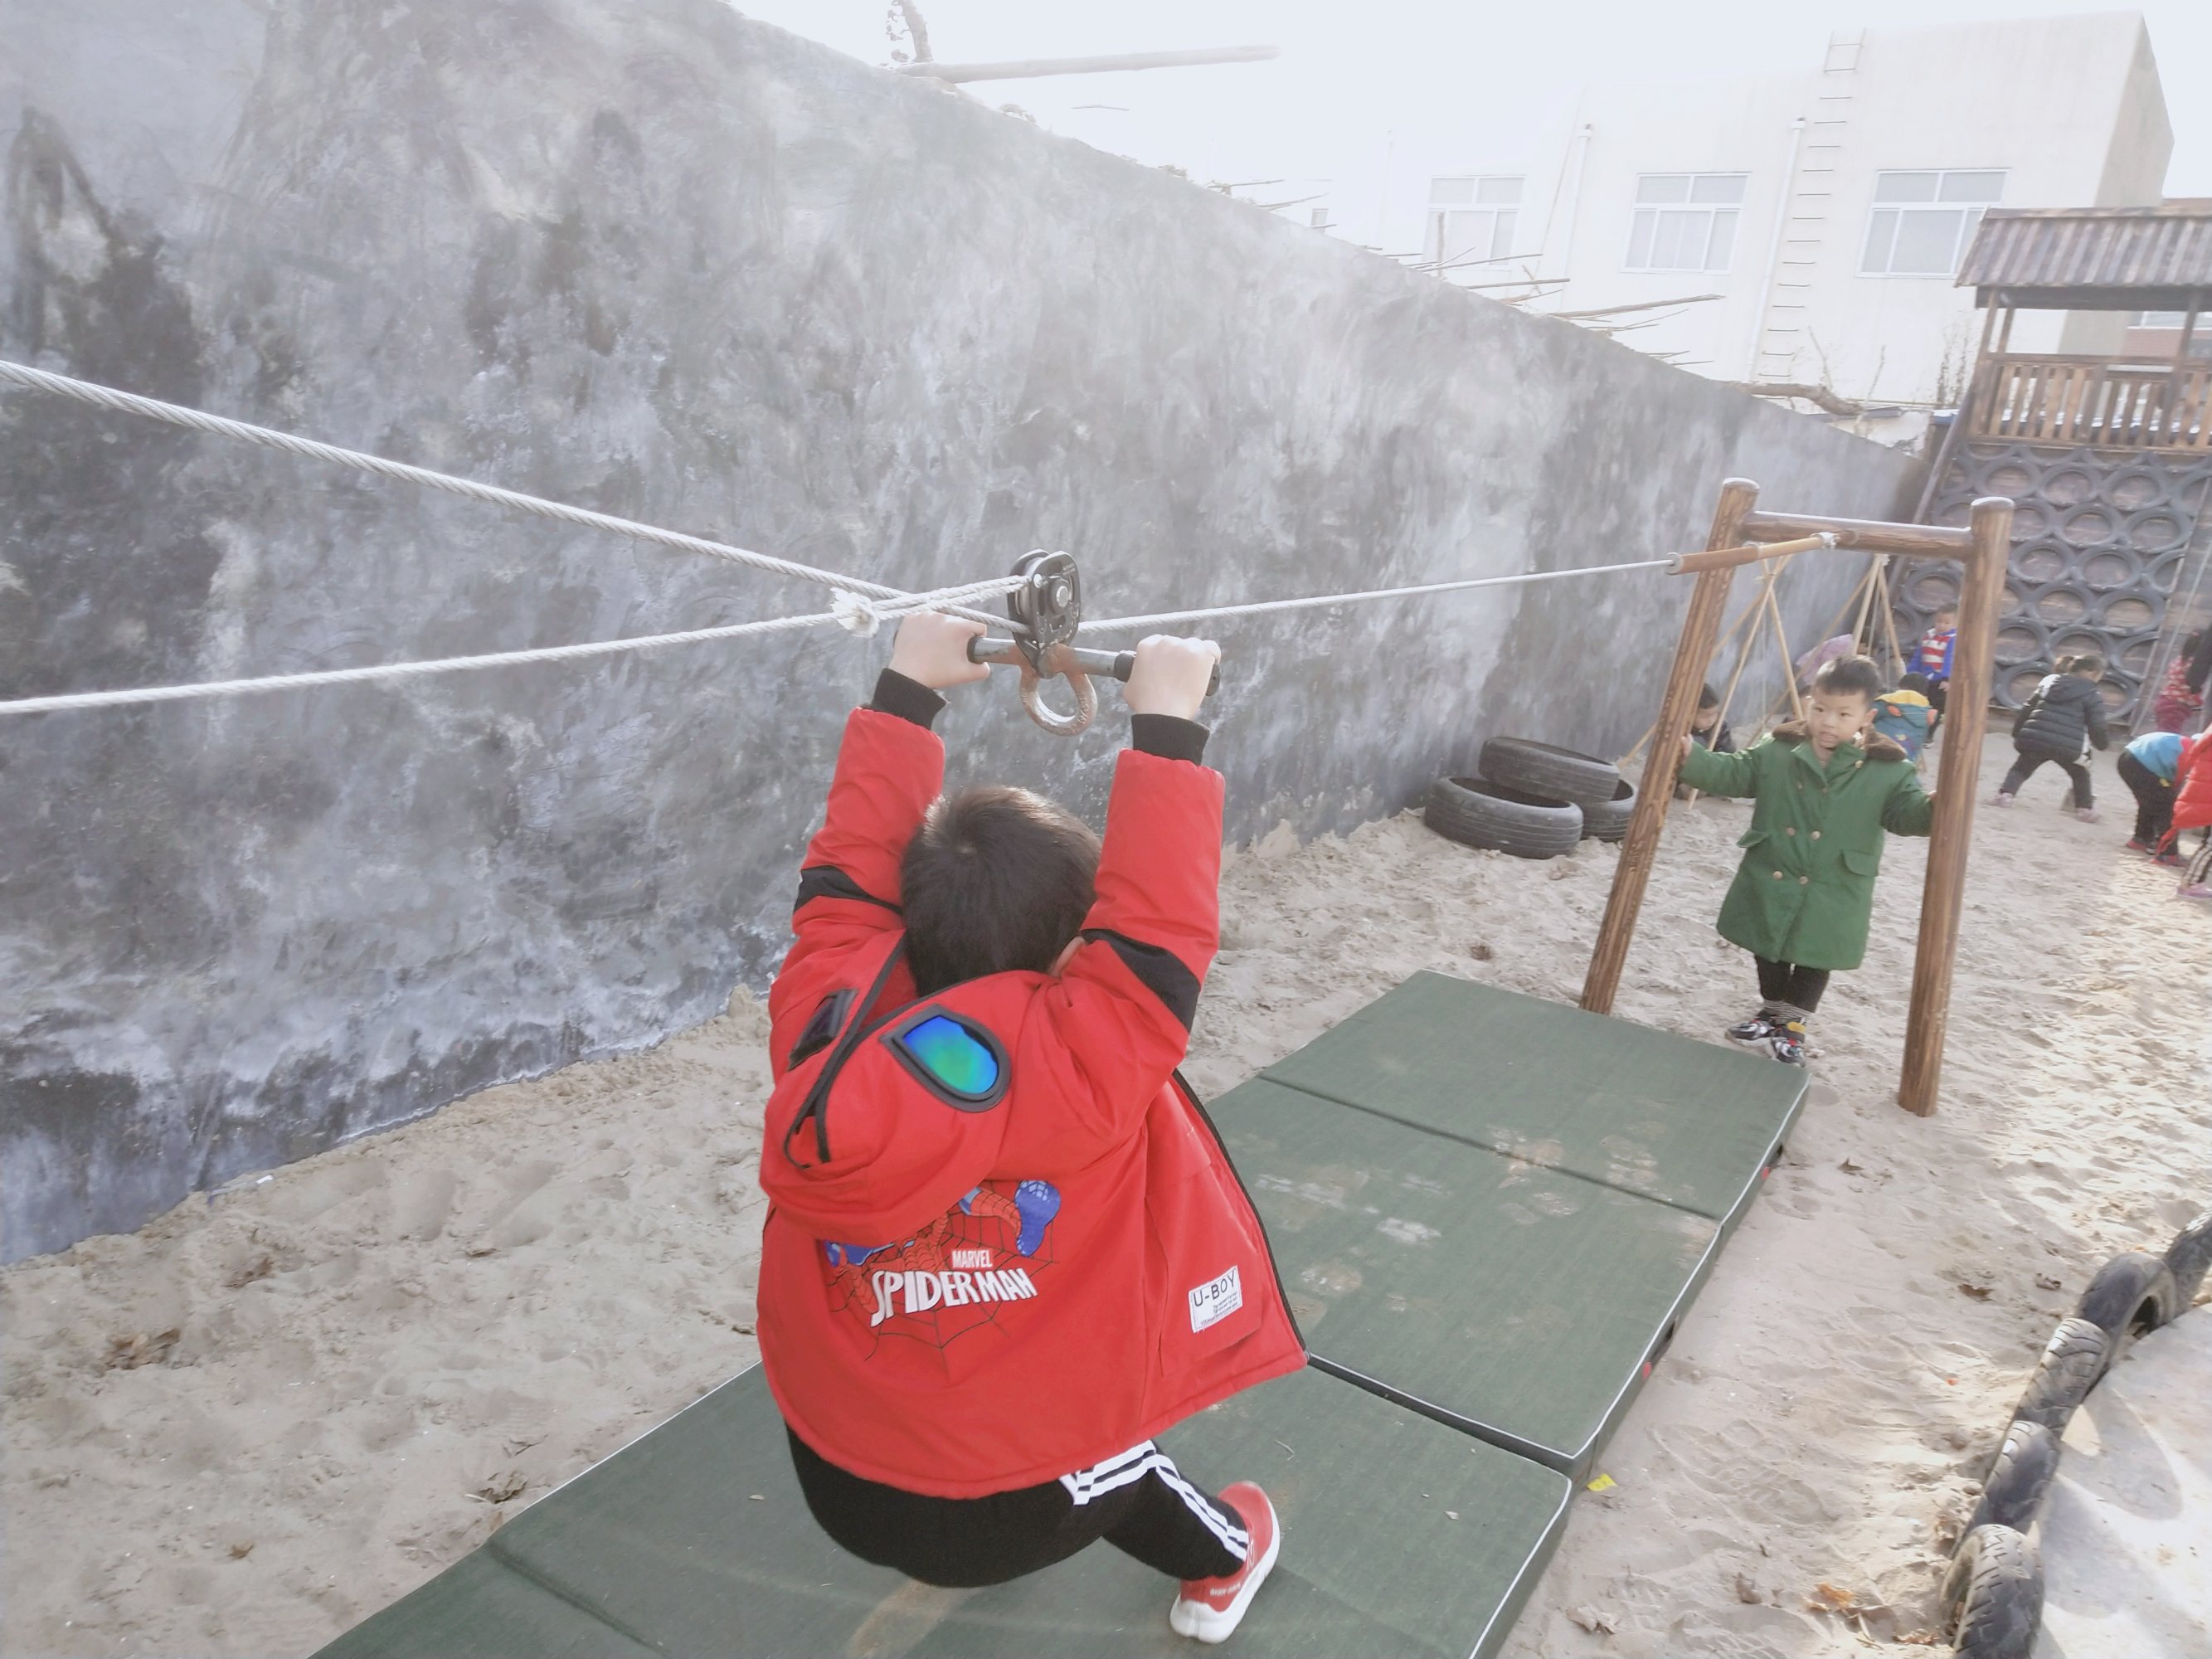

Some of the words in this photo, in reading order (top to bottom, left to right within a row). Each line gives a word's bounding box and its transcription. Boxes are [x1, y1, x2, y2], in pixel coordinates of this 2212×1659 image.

[952, 1249, 993, 1268] MARVEL
[871, 1268, 1038, 1327] SPIDERMAN
[1194, 1268, 1236, 1306] U-BOY
